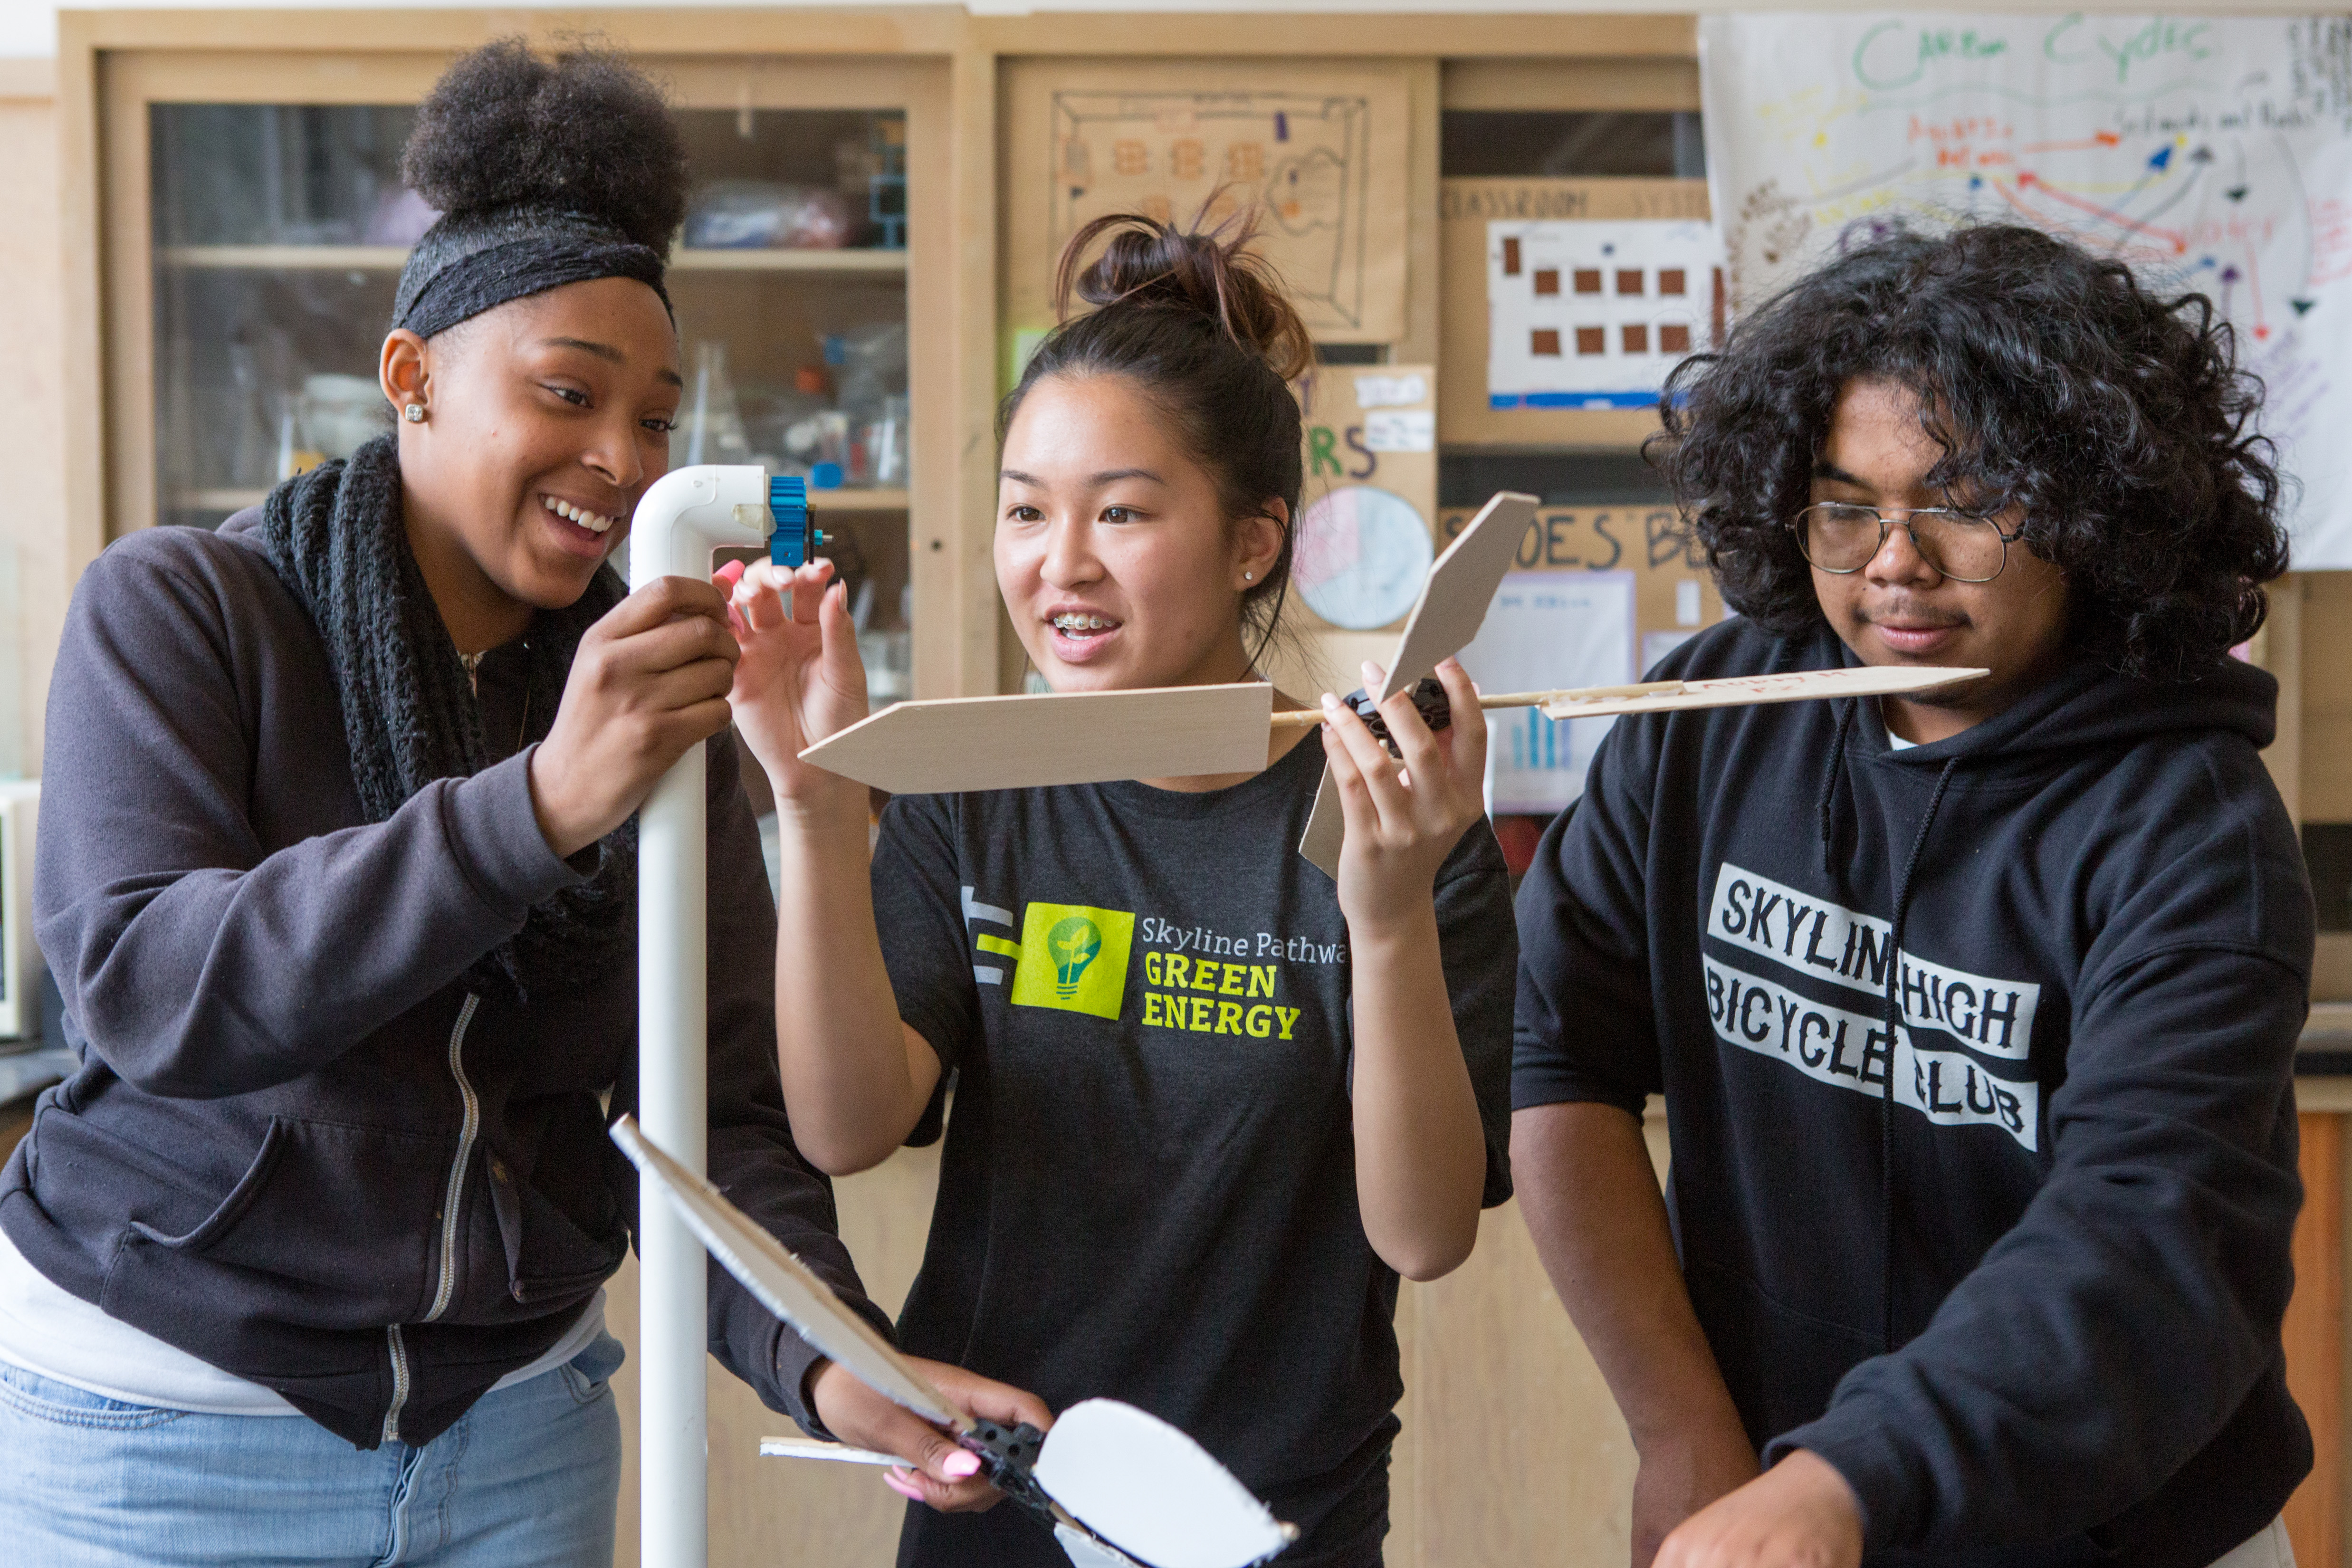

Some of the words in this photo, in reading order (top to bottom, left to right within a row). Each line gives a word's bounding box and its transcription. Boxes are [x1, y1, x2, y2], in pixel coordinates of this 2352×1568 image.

[1143, 918, 1247, 956] Skyline
[1145, 951, 1277, 998] GREEN
[1722, 879, 1900, 990] SKYLIN
[1902, 963, 2021, 1049] HIGH
[1142, 992, 1300, 1040] ENERGY
[1707, 966, 1899, 1084] BICYCLE
